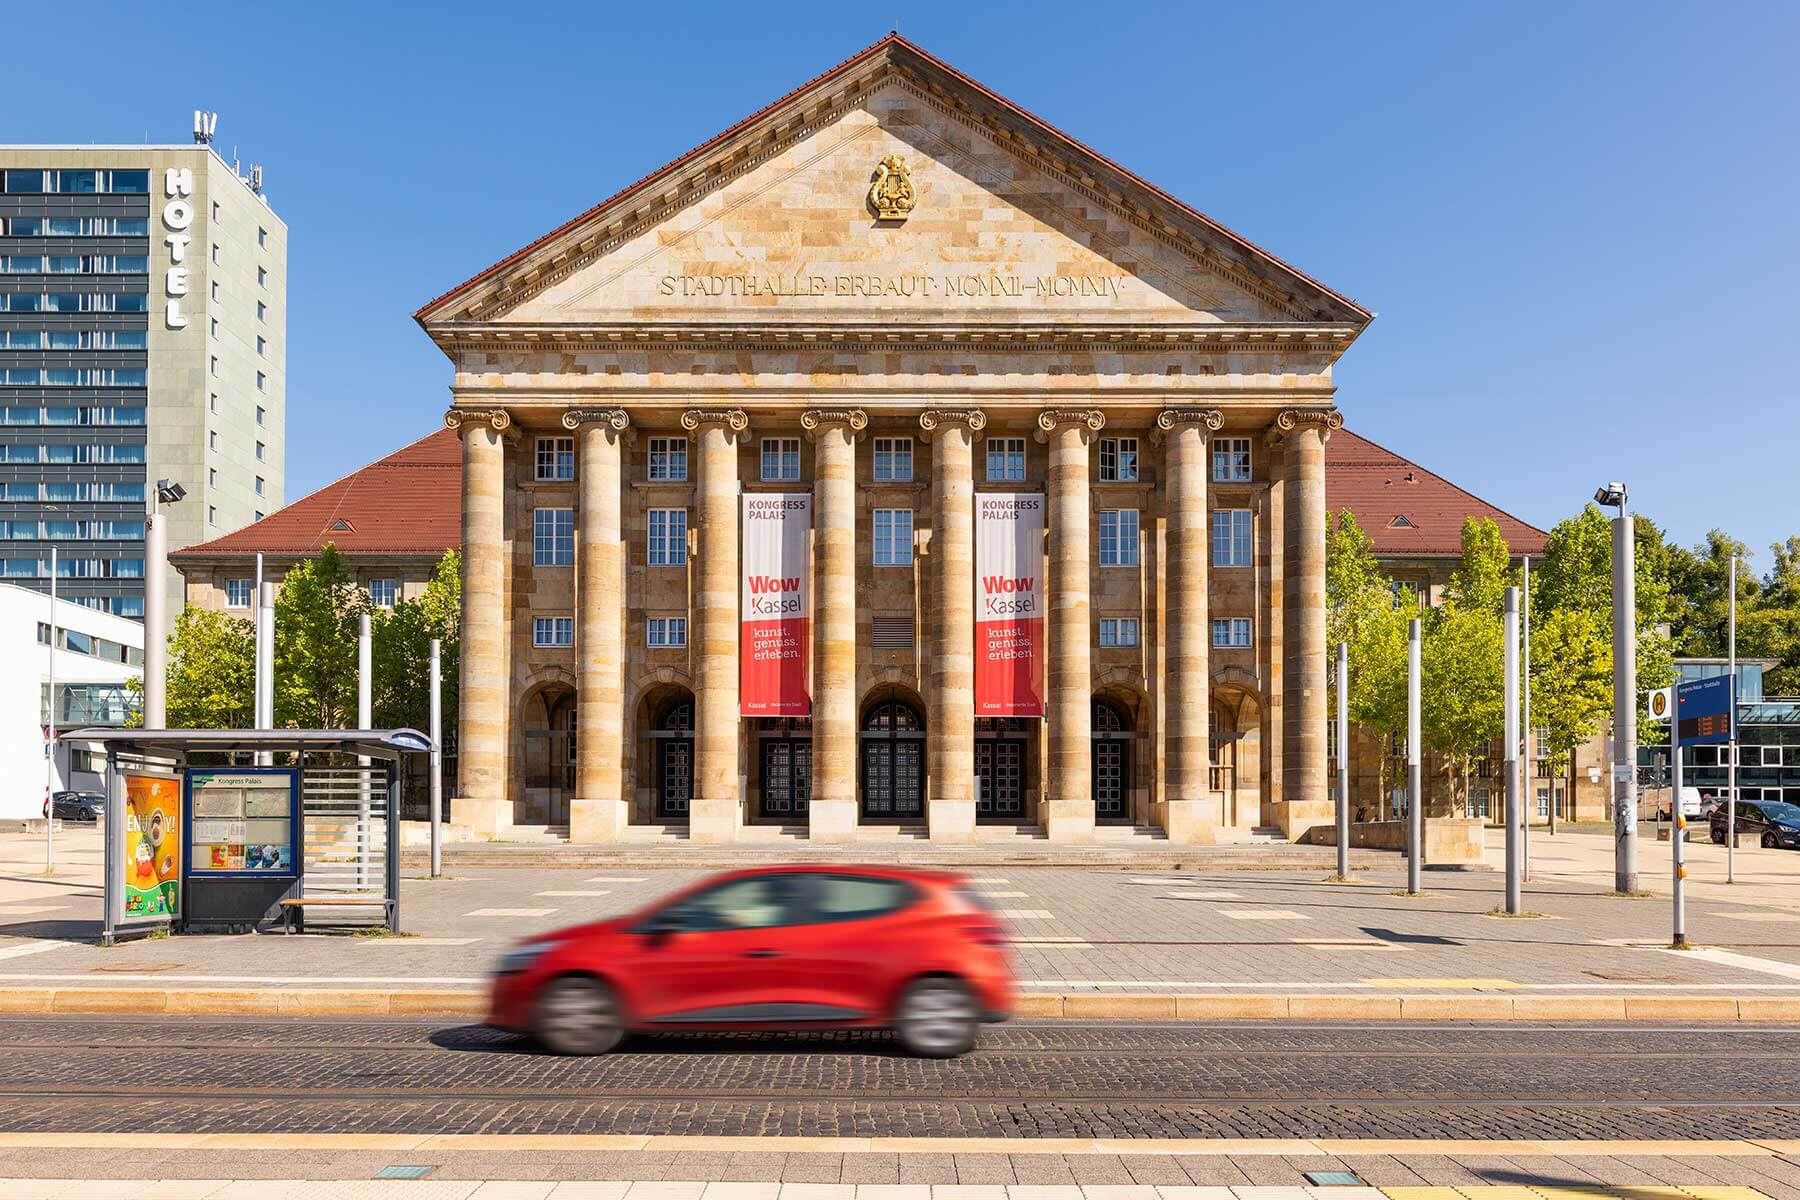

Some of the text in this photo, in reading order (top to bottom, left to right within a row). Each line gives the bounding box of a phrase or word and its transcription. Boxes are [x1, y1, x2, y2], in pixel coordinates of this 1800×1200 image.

[162, 167, 193, 329] HOTEL
[749, 500, 806, 510] KONGRESS
[982, 500, 1039, 510] KONGRESS
[749, 510, 786, 520] PALAIS
[982, 510, 1019, 520] PALAIS
[748, 575, 800, 594] Wow
[983, 575, 1033, 594] Wow
[753, 627, 791, 638] kunst.
[988, 627, 1025, 638] kunst.
[753, 638, 799, 651] genuss.
[988, 638, 1033, 651] genuss.
[753, 649, 801, 660] erleben.
